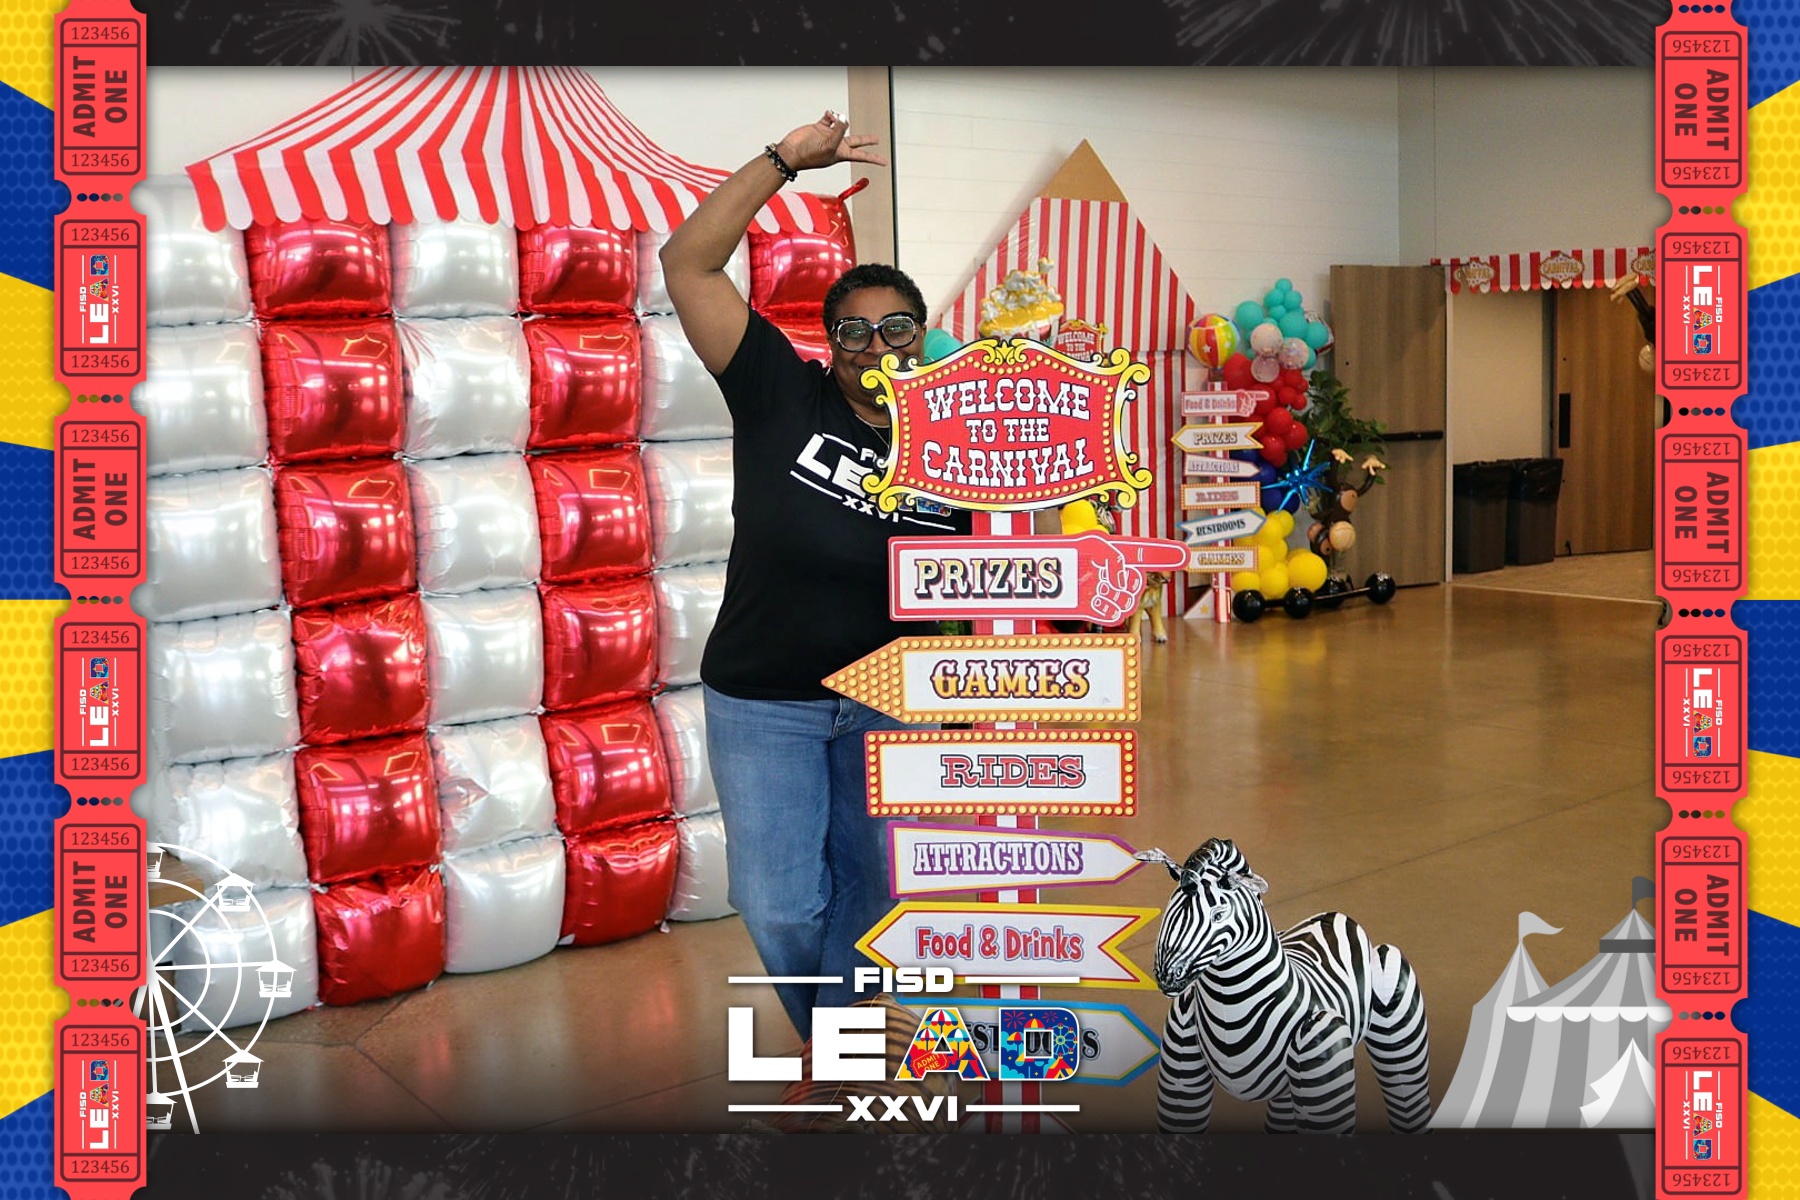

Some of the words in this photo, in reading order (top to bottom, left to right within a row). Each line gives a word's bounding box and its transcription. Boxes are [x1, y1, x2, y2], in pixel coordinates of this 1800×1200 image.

[923, 378, 1091, 422] WELCOME
[965, 418, 998, 444] TO
[1002, 418, 1050, 442] THE
[1193, 432, 1238, 445] PRIZES
[922, 438, 1094, 488] CARNIVAL
[1196, 518, 1246, 536] RESTROOMS
[914, 558, 1063, 599] PRIZES
[930, 659, 1090, 701] GAMES
[940, 754, 1086, 789] RIDES
[913, 841, 1084, 877] ATTRACTIONS
[916, 924, 973, 959] Food
[978, 926, 1000, 958] &
[1004, 926, 1084, 962] Drinks
